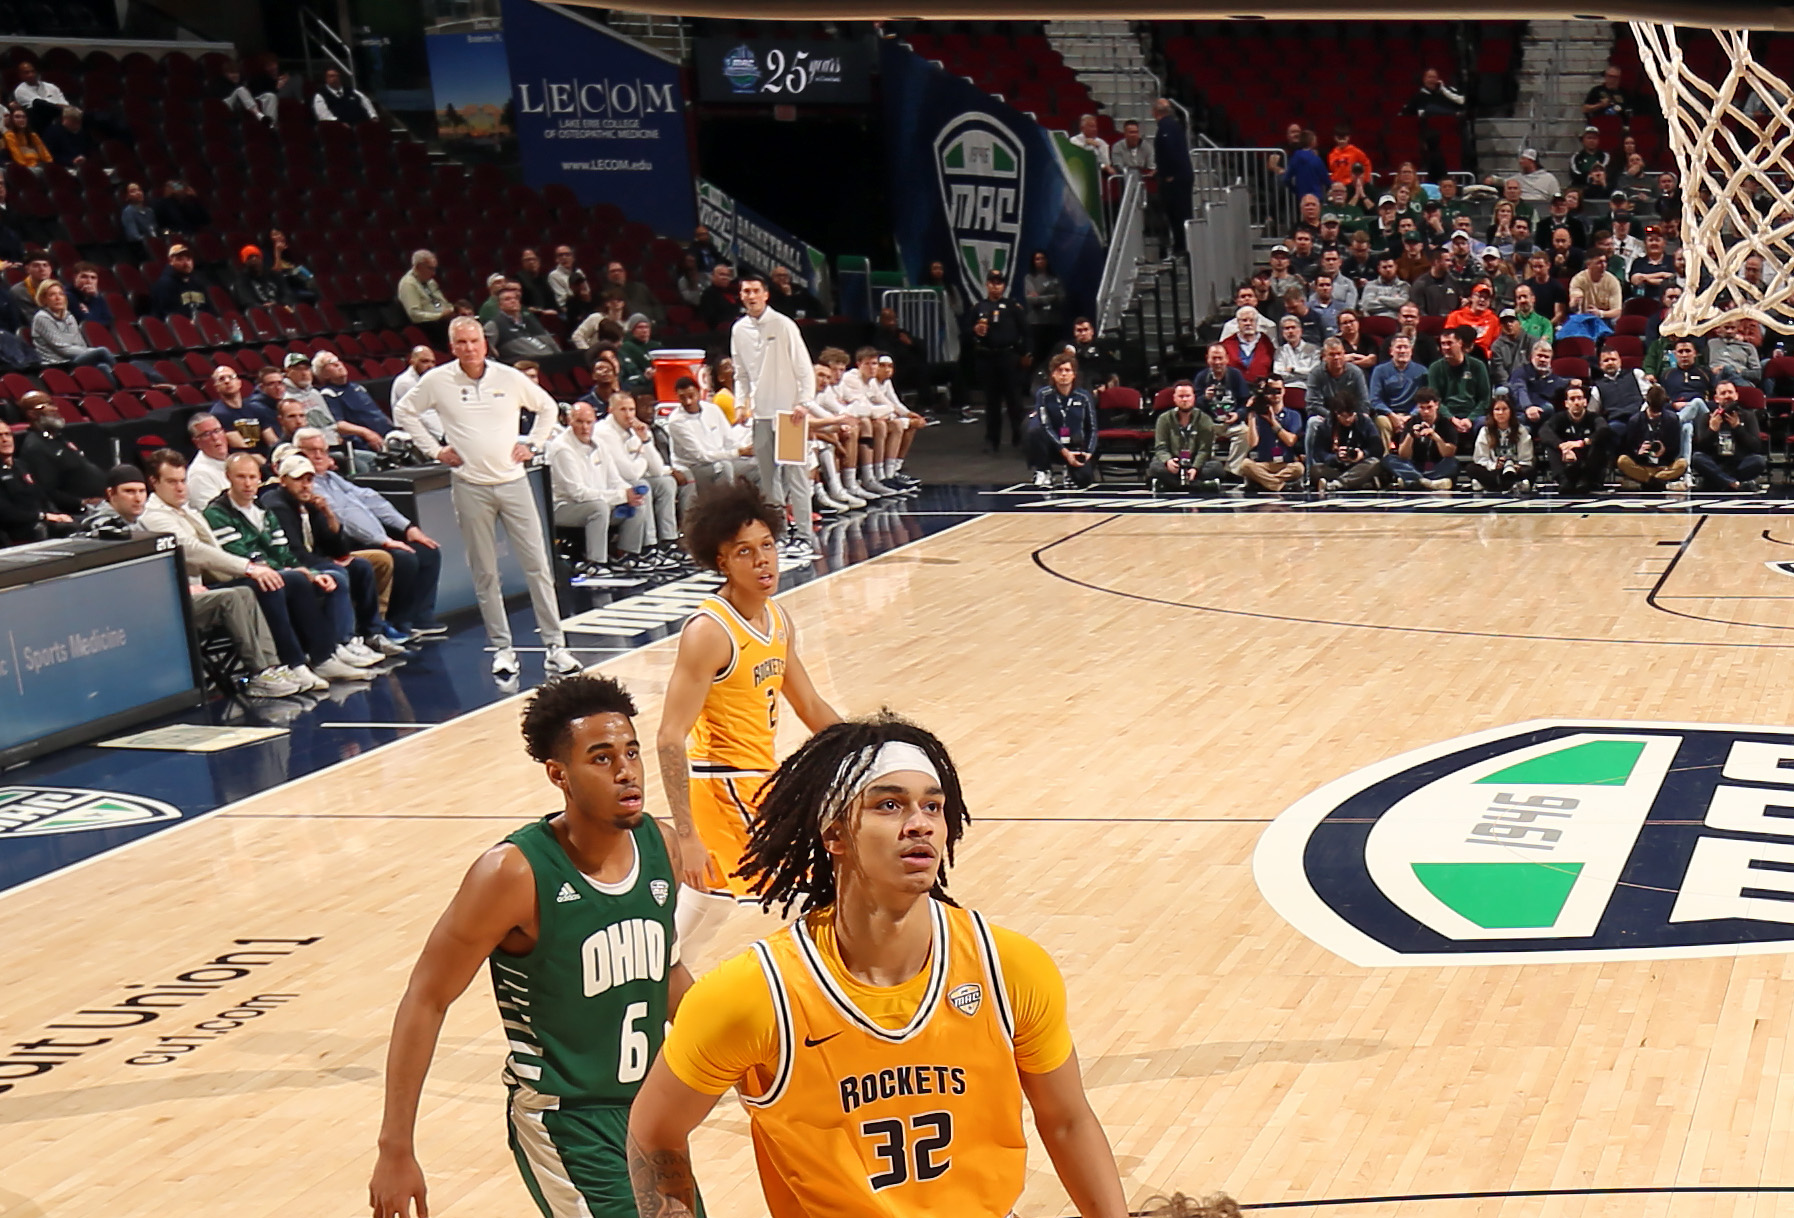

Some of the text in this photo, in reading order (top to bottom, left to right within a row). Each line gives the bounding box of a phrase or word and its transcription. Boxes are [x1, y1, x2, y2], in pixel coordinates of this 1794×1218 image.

[760, 49, 809, 93] 25
[544, 130, 660, 139] OF OSTEOPATHIC MEDICINE
[559, 119, 581, 128] LAKE
[603, 119, 640, 128] COLLEGE
[561, 160, 653, 170] www.LECOM.edu
[948, 184, 1021, 234] MAC
[23, 641, 69, 674] Sports
[68, 626, 127, 658] Medicine
[1465, 792, 1581, 851] 1946
[581, 918, 667, 999] OHIO
[125, 993, 301, 1066] cu1.com
[617, 1002, 648, 1084] 6
[838, 1066, 967, 1114] ROCKETS
[859, 1111, 952, 1194] 32
